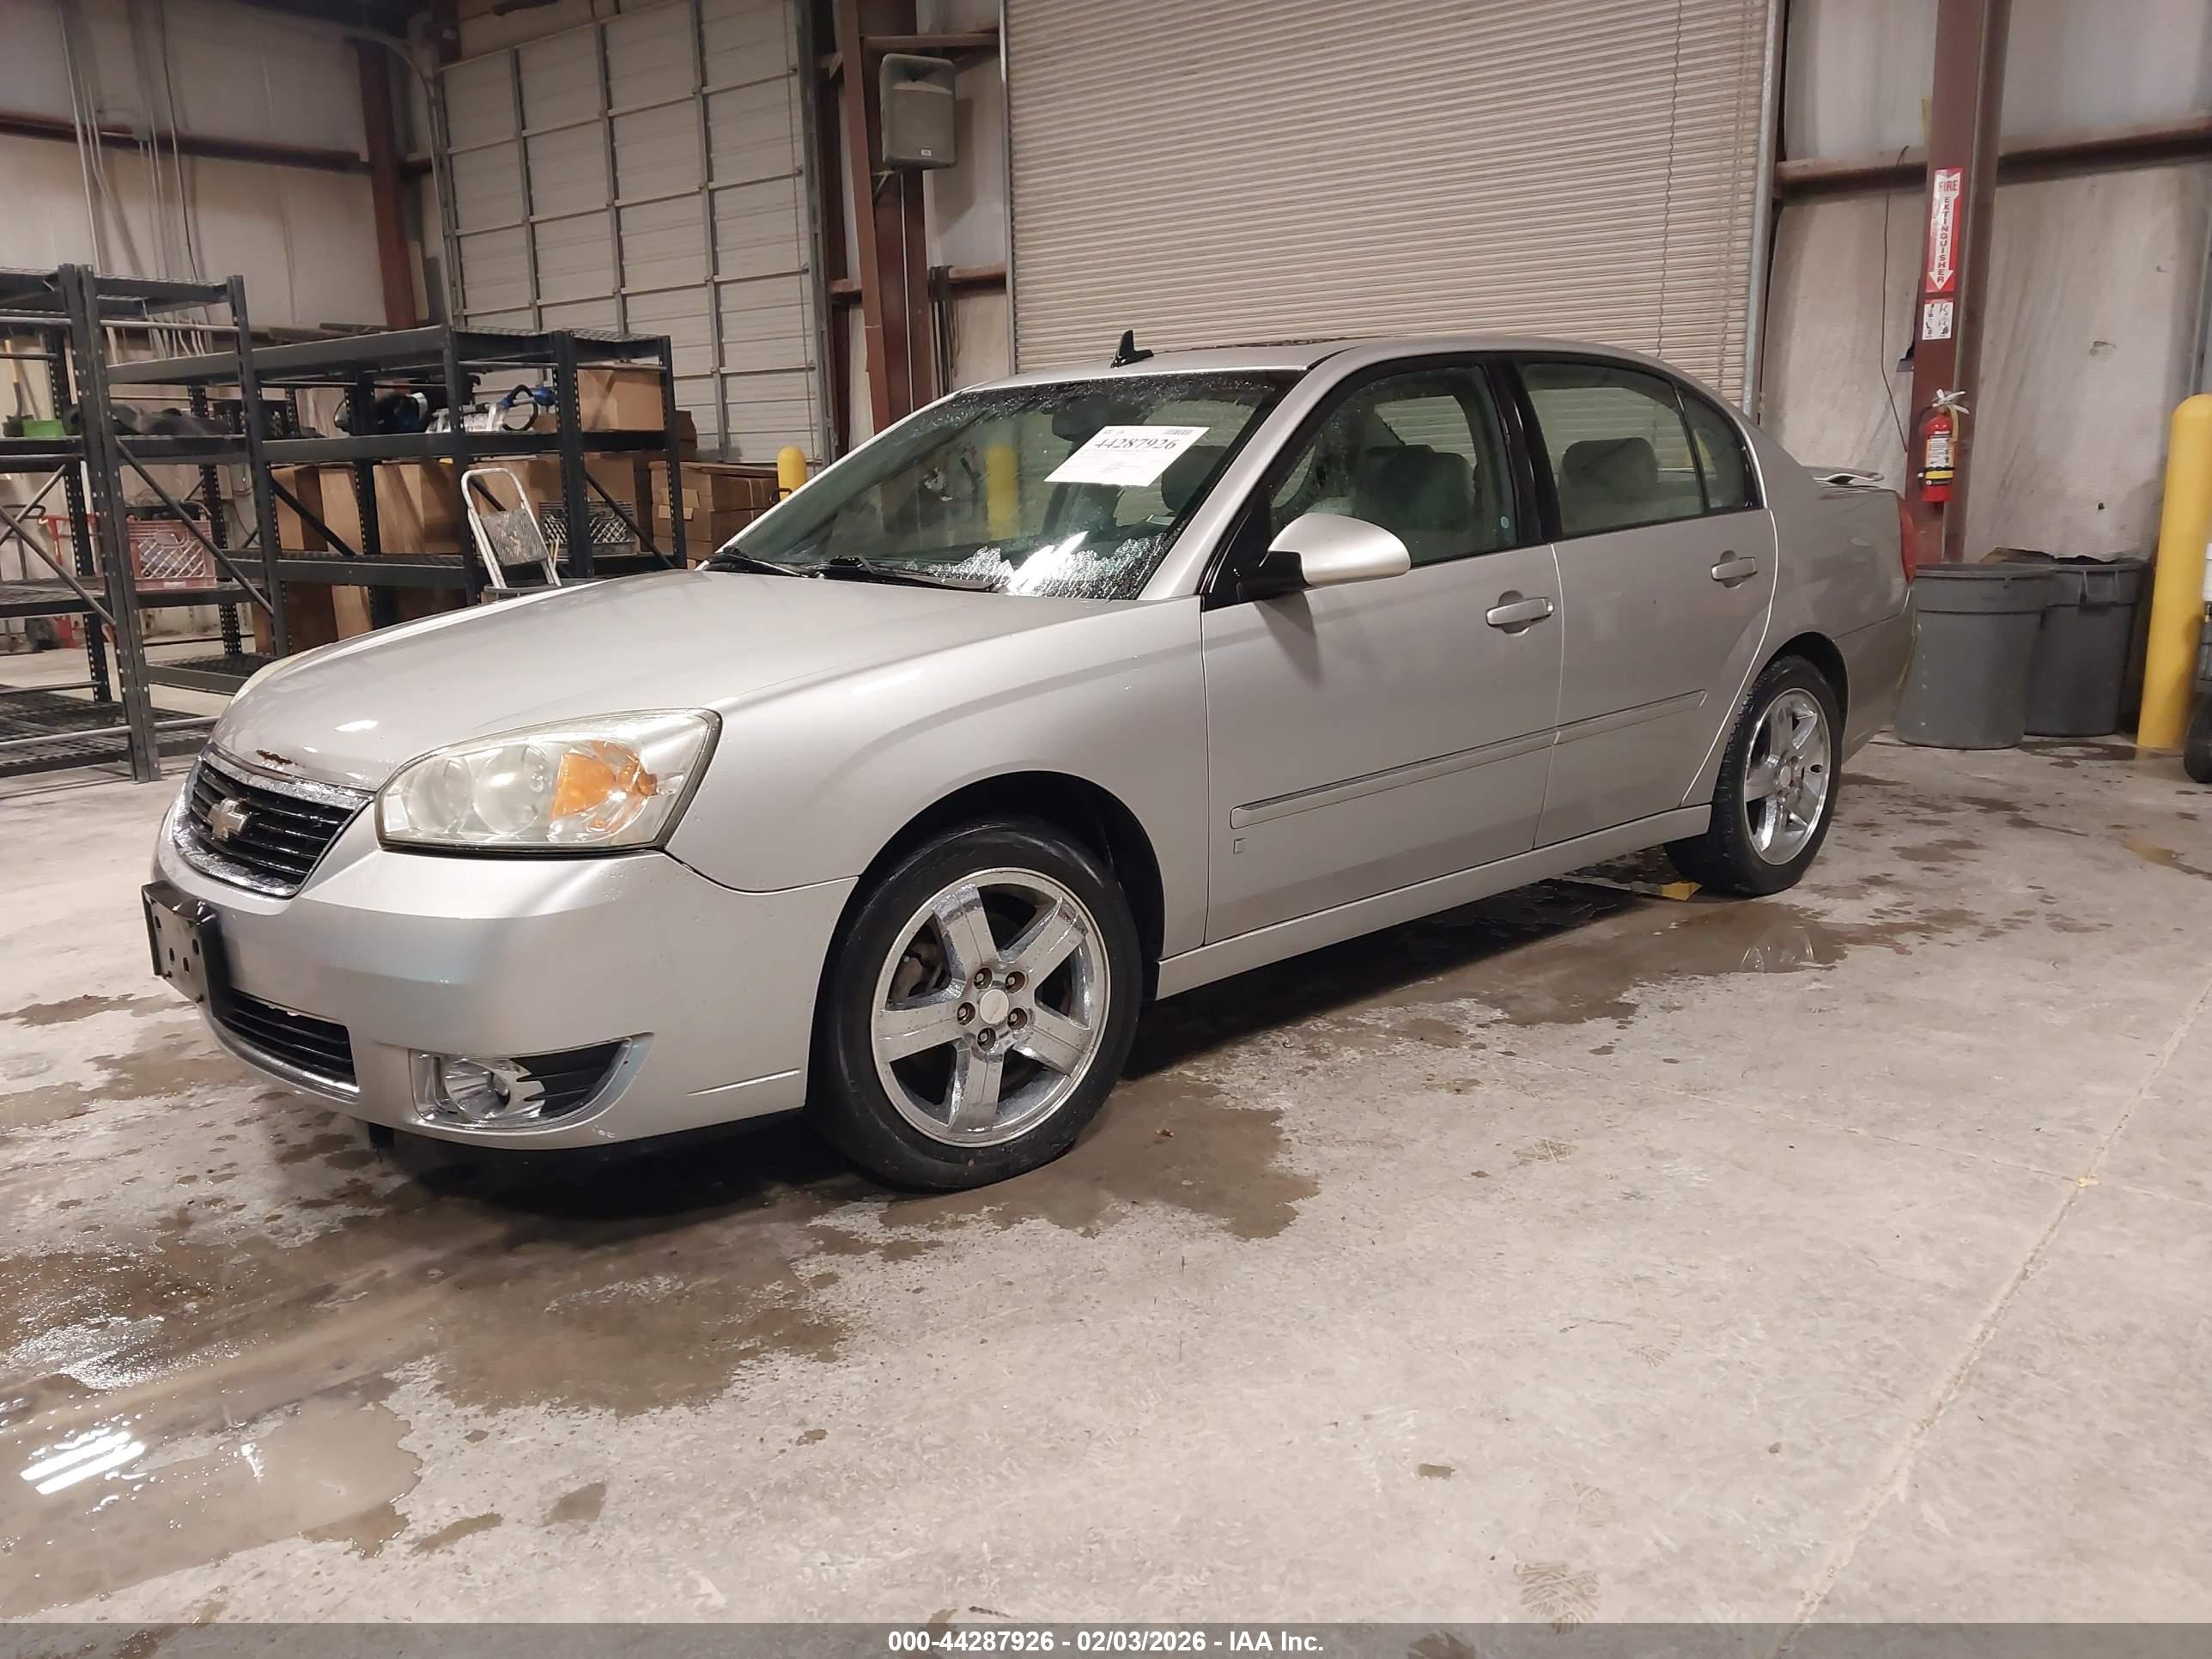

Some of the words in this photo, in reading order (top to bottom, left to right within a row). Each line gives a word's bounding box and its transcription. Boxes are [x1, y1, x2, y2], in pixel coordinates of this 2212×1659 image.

[1938, 179, 1958, 192] FIRE
[1937, 197, 1951, 283] EXTINGUISHER
[1095, 438, 1179, 450] 44287926
